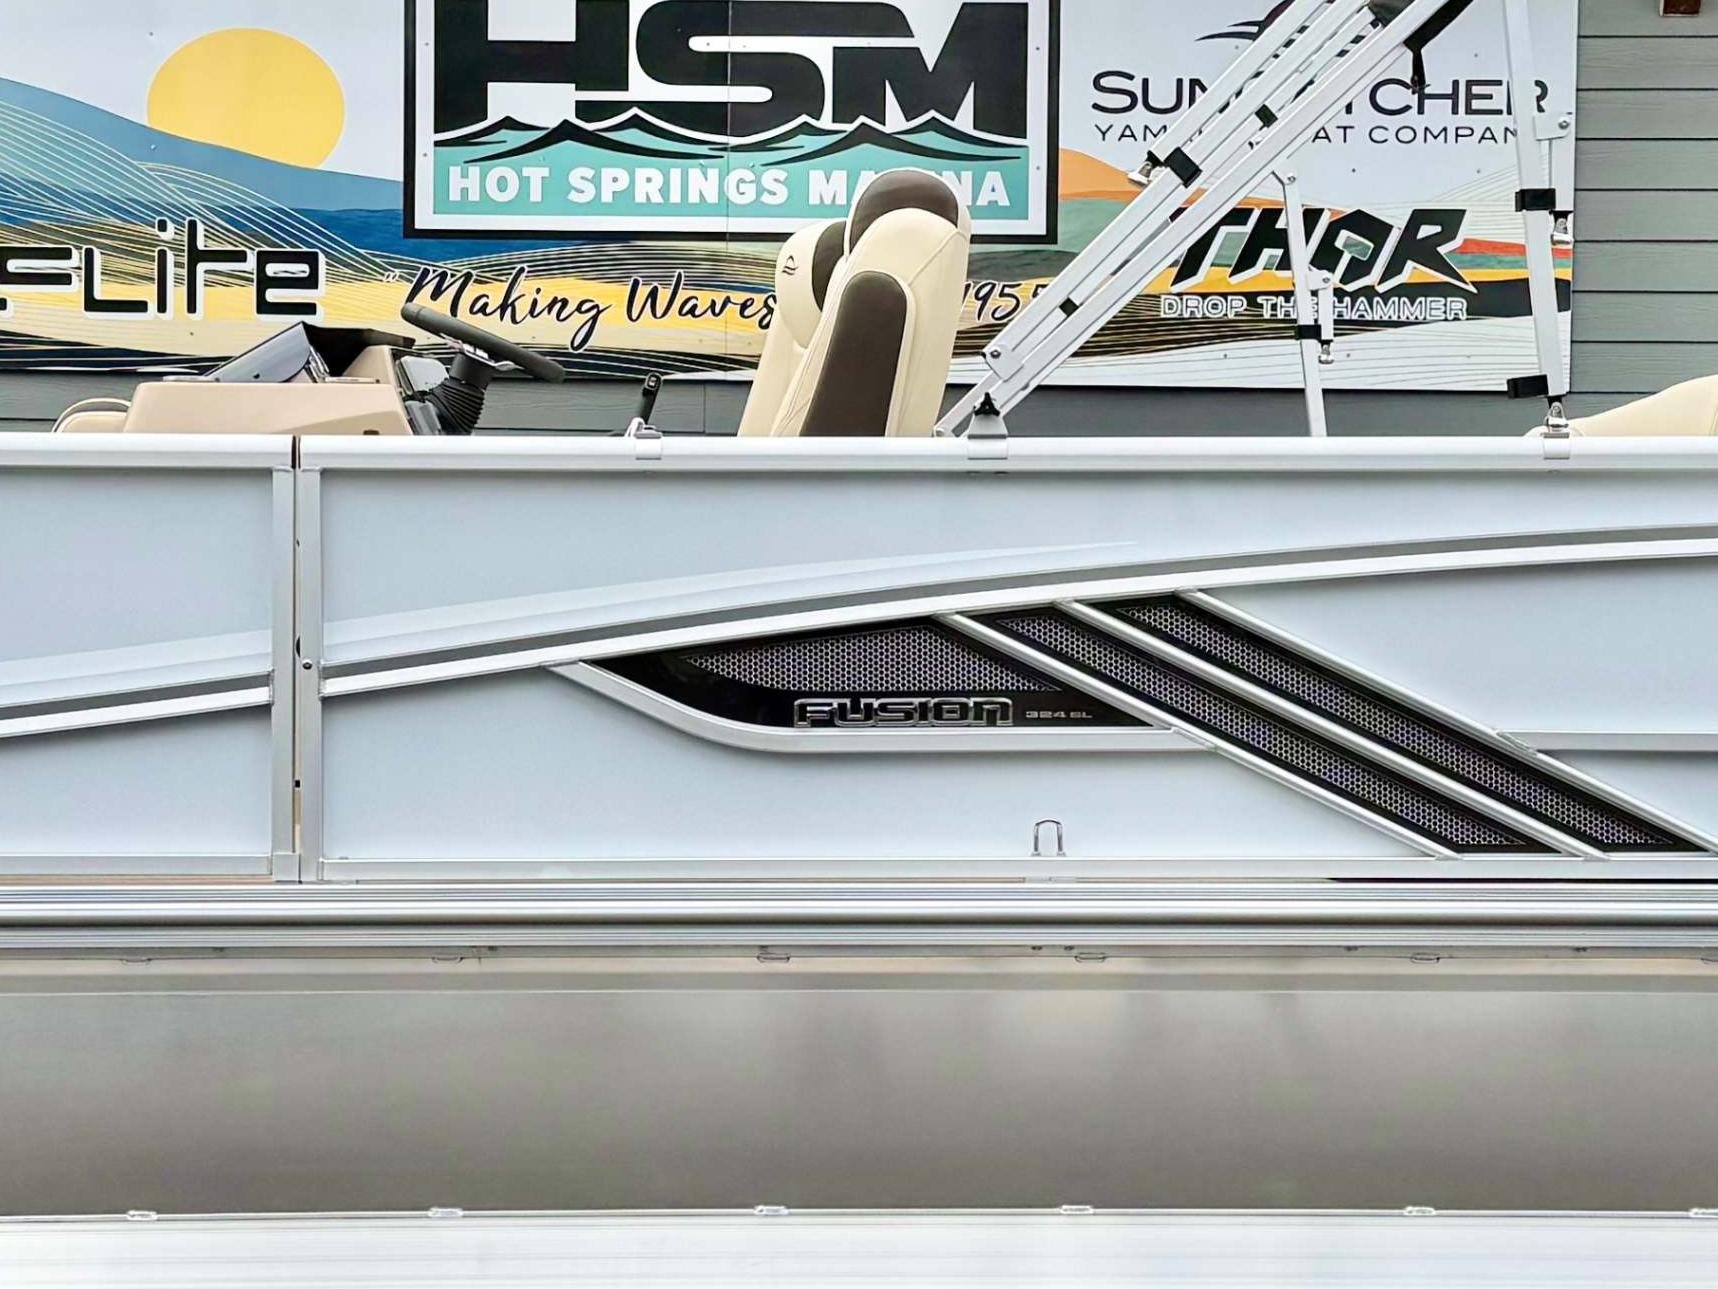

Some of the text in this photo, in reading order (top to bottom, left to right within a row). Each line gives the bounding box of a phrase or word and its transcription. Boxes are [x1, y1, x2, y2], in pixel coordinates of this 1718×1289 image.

[447, 165, 551, 203] HOT
[566, 166, 790, 206] SPRINGS
[625, 268, 777, 330] Waves
[1159, 295, 1245, 320] DROP
[1333, 296, 1467, 321] HAMMER
